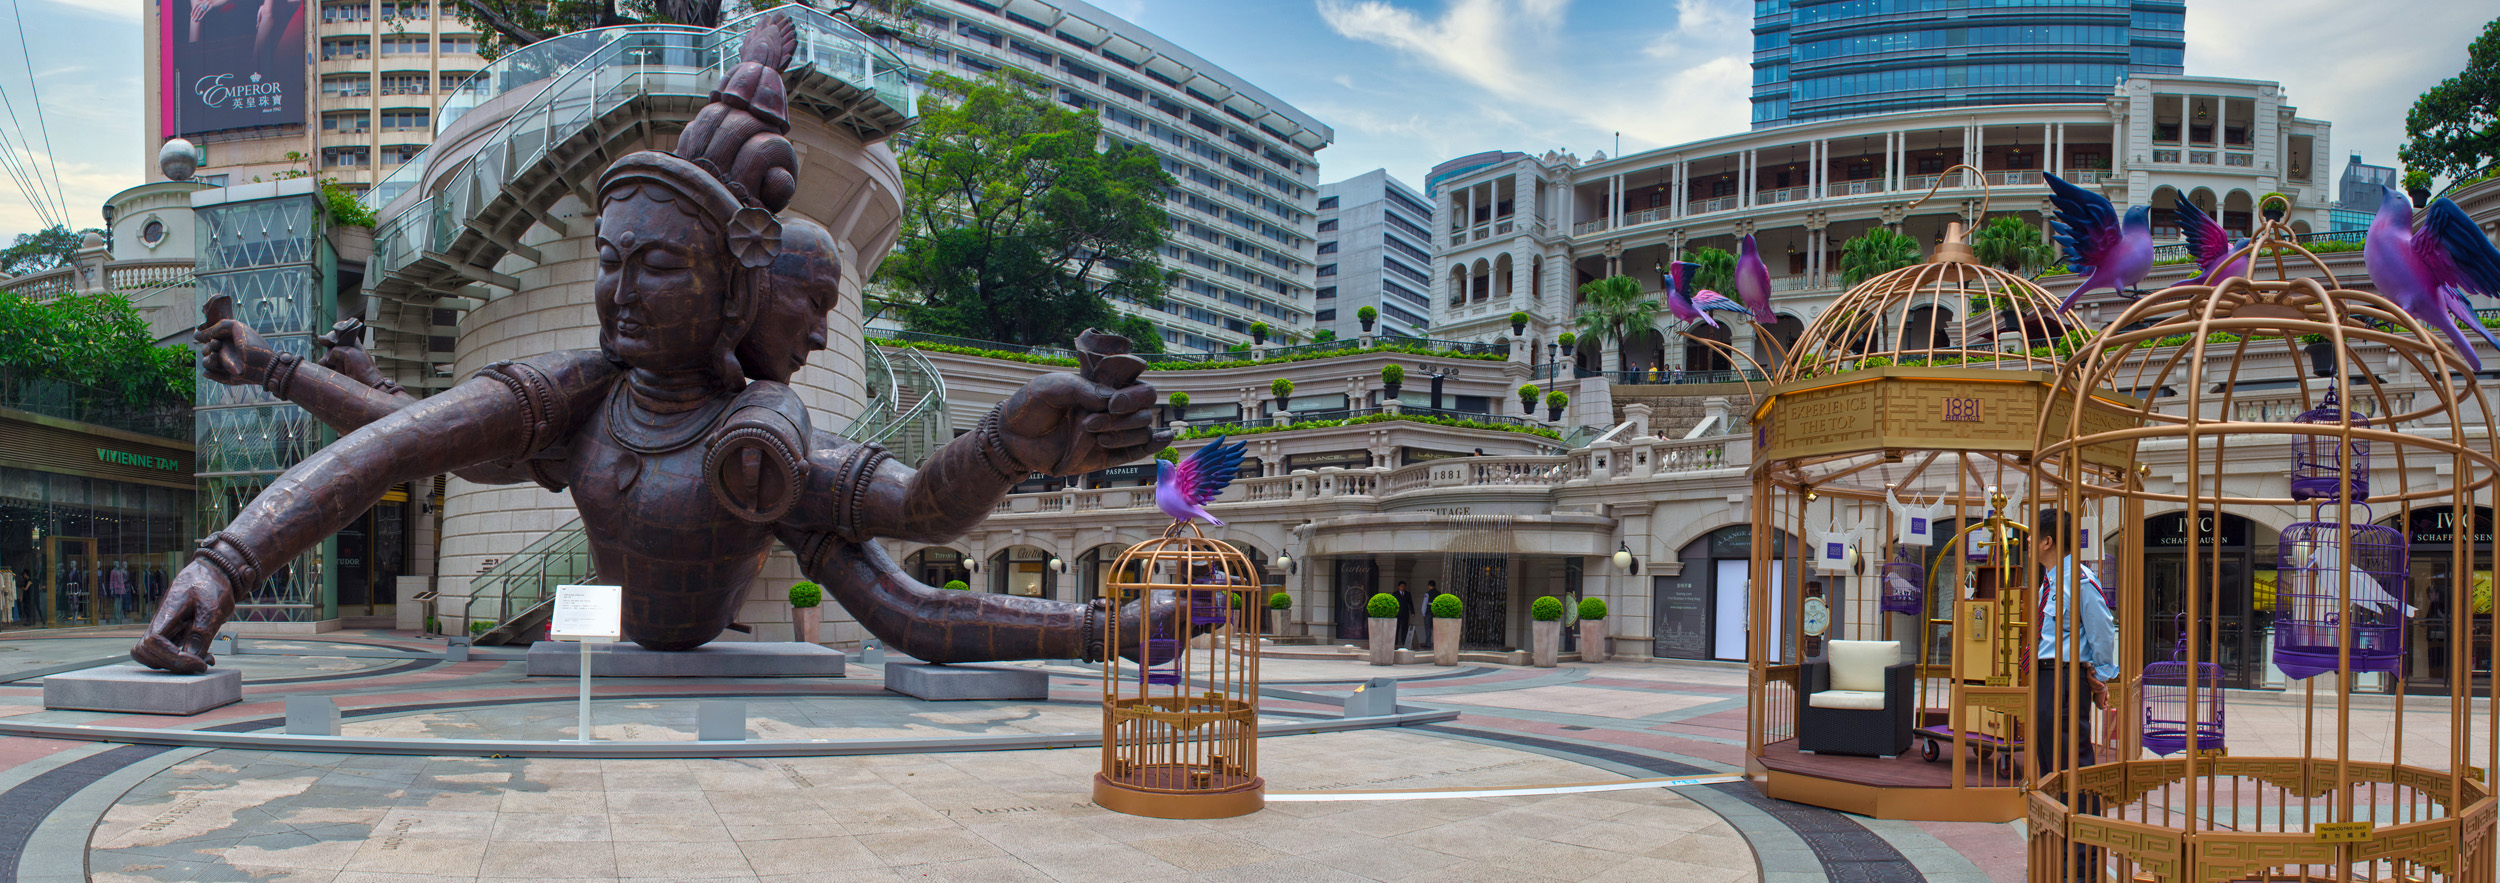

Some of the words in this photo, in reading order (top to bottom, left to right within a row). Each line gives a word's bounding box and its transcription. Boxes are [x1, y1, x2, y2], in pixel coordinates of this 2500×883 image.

[232, 94, 282, 110] 英皇珠寶
[1791, 396, 1867, 420] EXPERIENCE
[1946, 398, 1980, 417] 1881
[2055, 402, 2121, 430] EXRIENCE
[1800, 419, 1826, 435] THE
[1828, 415, 1856, 430] TOP
[96, 447, 153, 468] VIVIENNE
[155, 457, 178, 471] TAM
[1309, 454, 1346, 462] LANCEL
[1105, 467, 1139, 476] PASPALEY
[1433, 470, 1462, 481] 1881
[1416, 506, 1471, 516] ITAGE
[2160, 536, 2229, 545] SCHAFAUSN
[2417, 533, 2493, 542] SCHAFFASEN
[1341, 562, 1371, 573] Cartier
